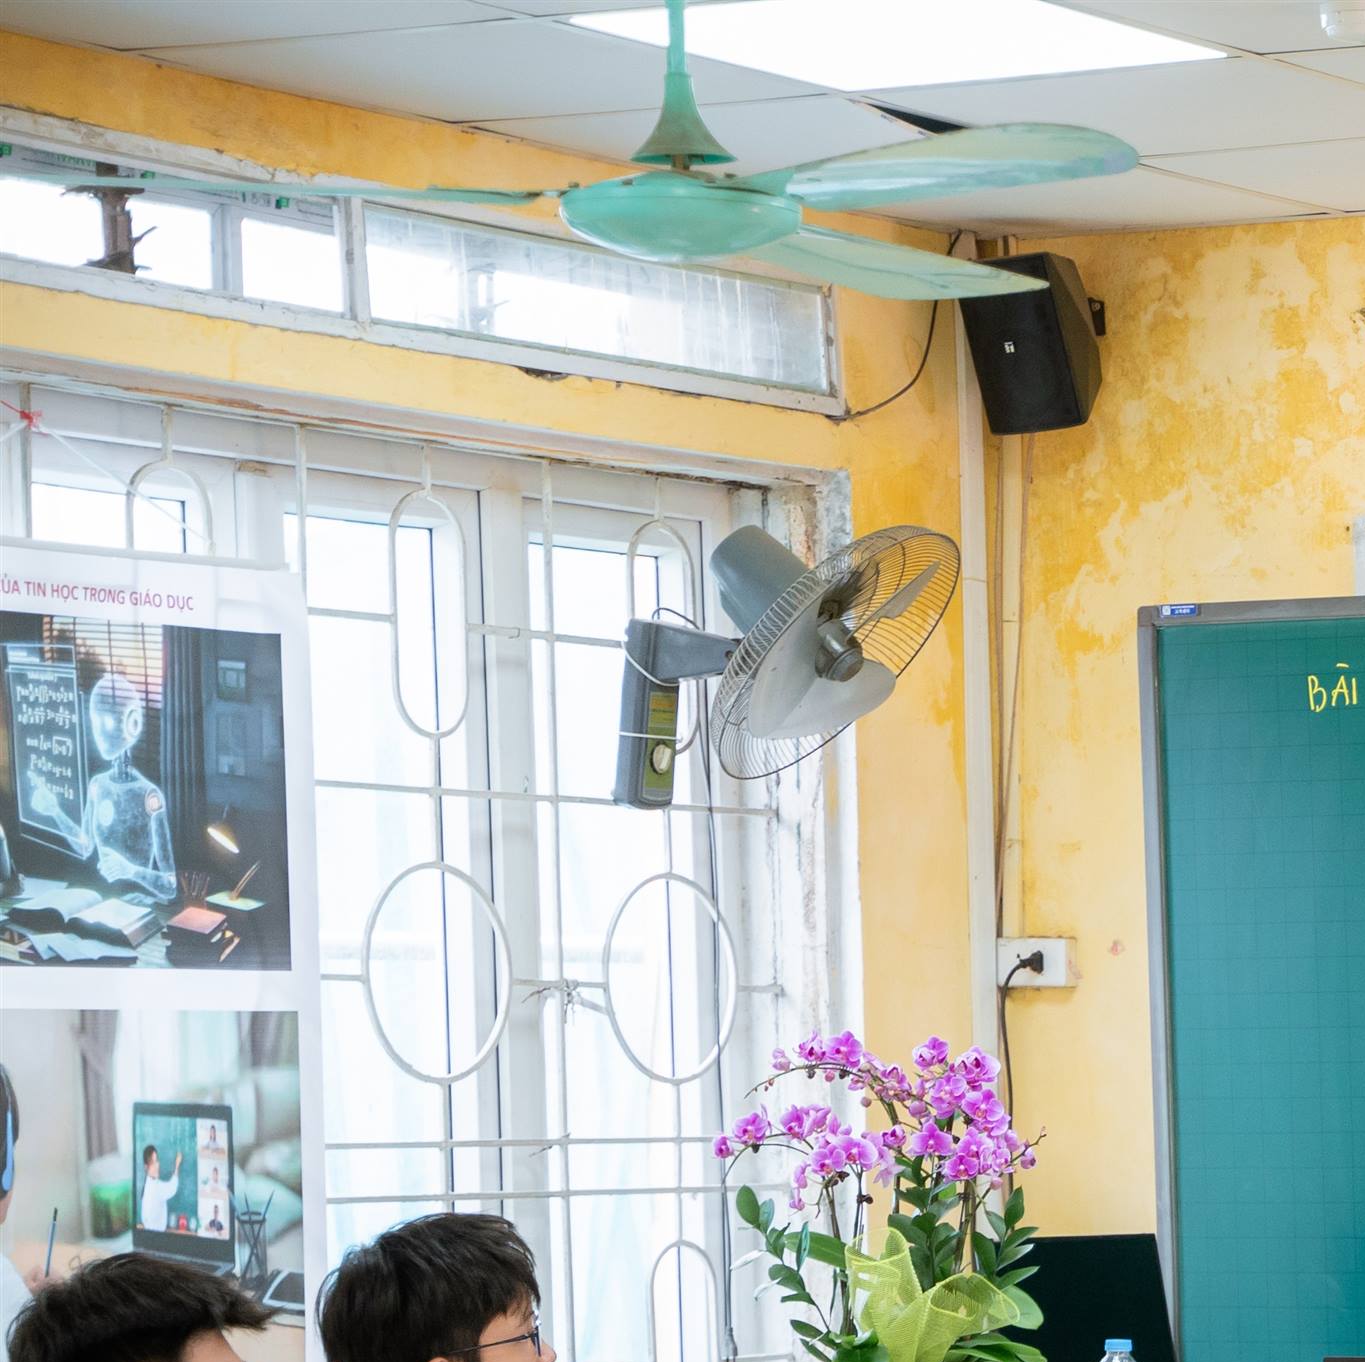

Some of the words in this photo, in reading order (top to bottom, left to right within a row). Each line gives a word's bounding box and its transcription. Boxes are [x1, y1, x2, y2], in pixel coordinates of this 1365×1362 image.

[24, 580, 47, 598] TIN
[51, 583, 79, 603] HỌC
[83, 586, 126, 605] TRONG
[129, 589, 163, 608] GIÁO
[166, 594, 195, 613] DỤC
